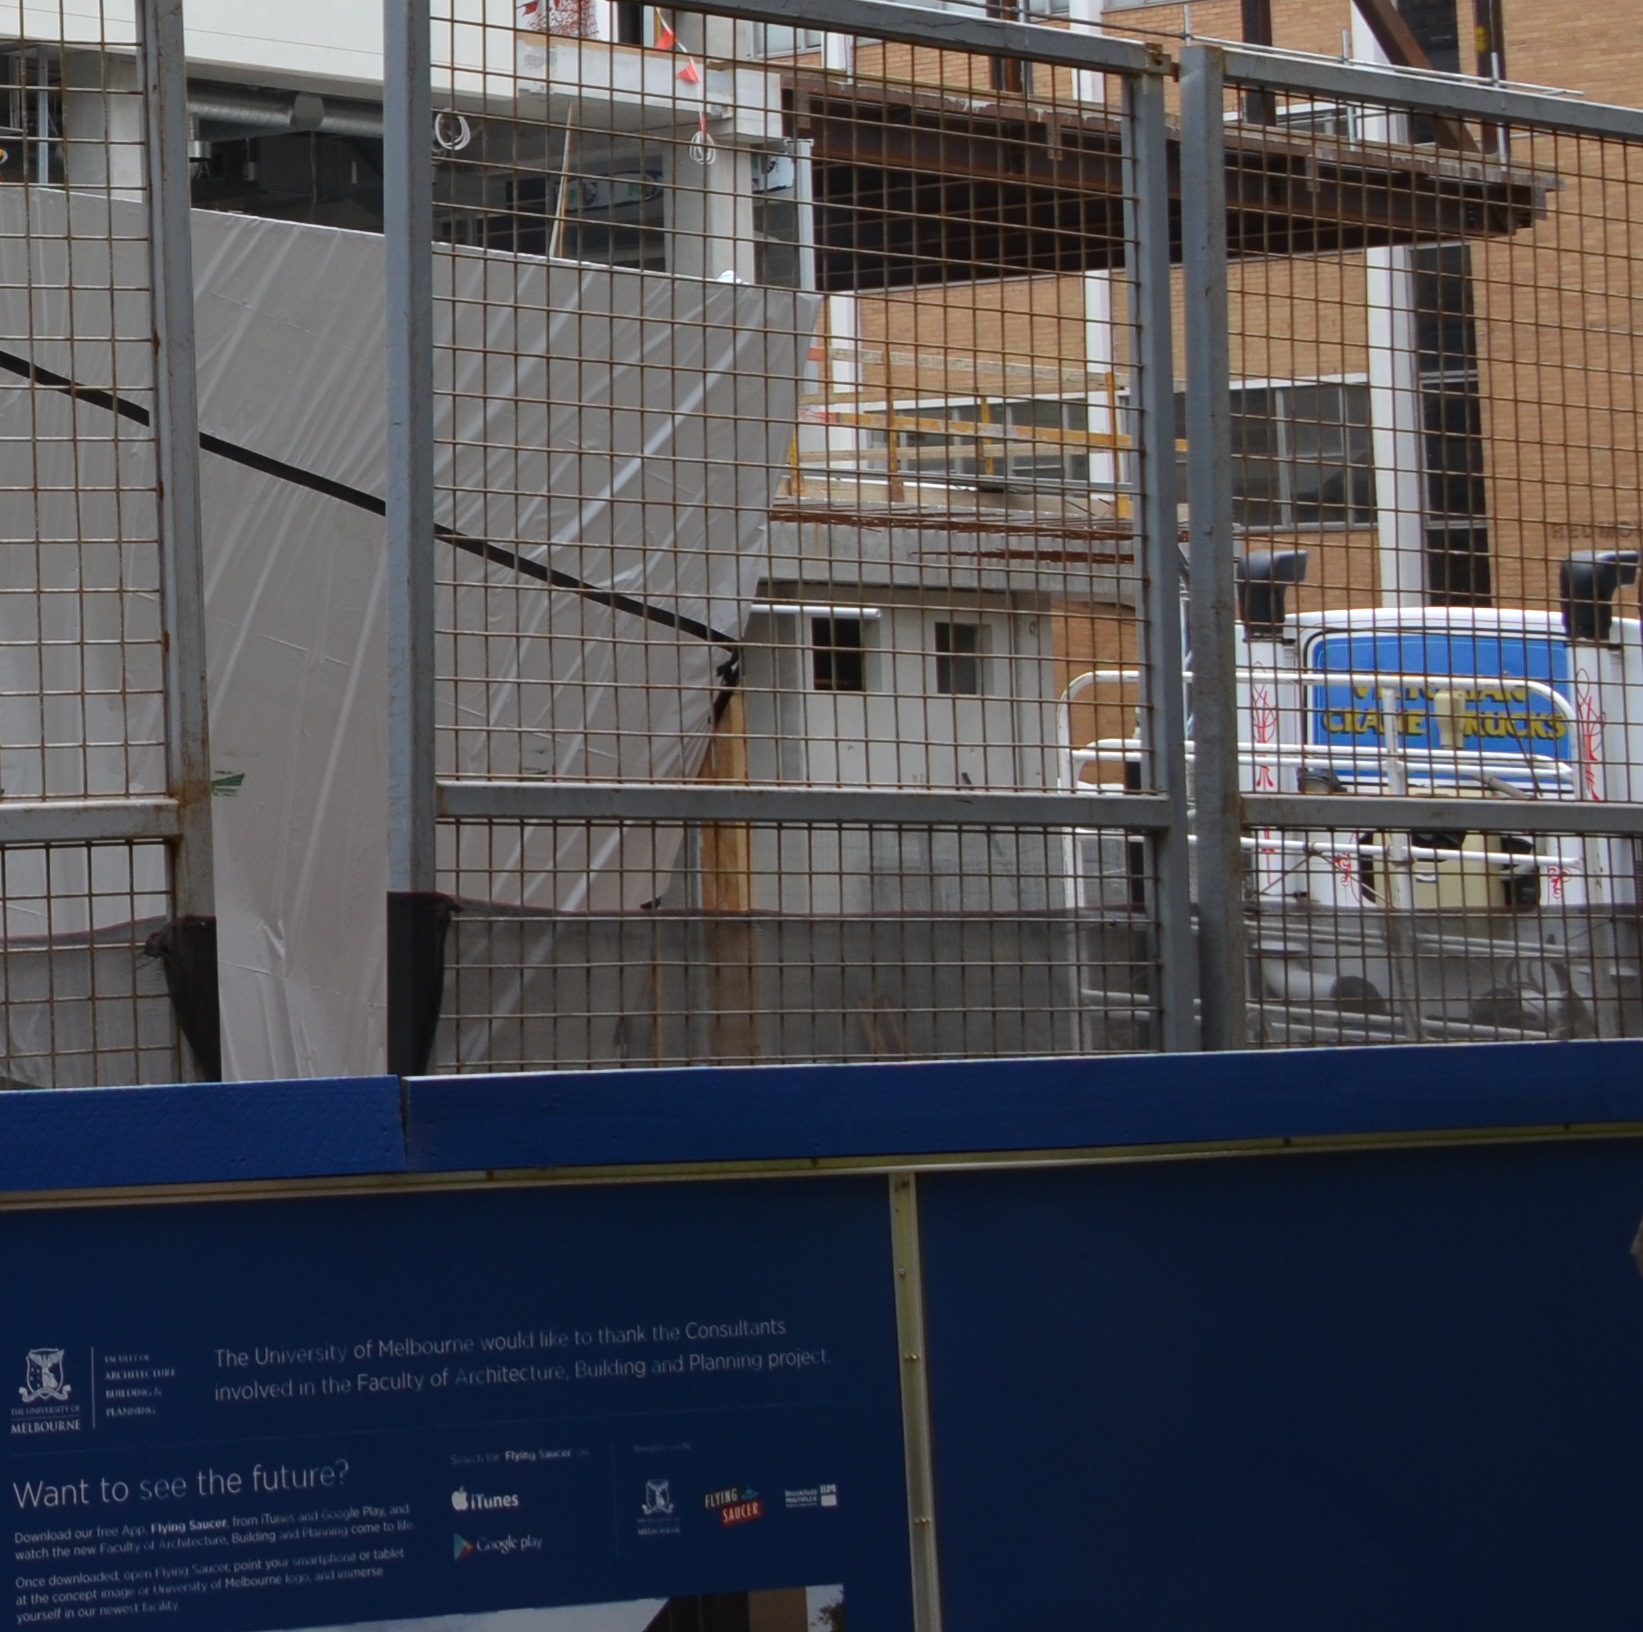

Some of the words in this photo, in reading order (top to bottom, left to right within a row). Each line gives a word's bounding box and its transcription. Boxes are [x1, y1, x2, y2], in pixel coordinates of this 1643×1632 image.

[1459, 711, 1566, 740] RUCKS
[215, 1349, 249, 1368] The
[255, 1344, 348, 1366] University
[354, 1340, 372, 1359] of
[379, 1338, 474, 1358] Melbourne
[480, 1330, 534, 1351] would
[540, 1330, 568, 1348] like
[575, 1329, 593, 1345] to
[598, 1325, 646, 1344] thank
[653, 1323, 681, 1342] the
[686, 1318, 785, 1340] Consultants
[105, 1368, 176, 1381] ARCHITECTURE
[215, 1380, 292, 1402] involved
[299, 1378, 315, 1396] in
[322, 1376, 351, 1394] the
[358, 1371, 424, 1393] Faculty
[430, 1368, 449, 1388] of
[455, 1360, 569, 1386] Architecture,
[575, 1359, 646, 1379] Building
[652, 1354, 683, 1375] and
[689, 1351, 762, 1372] Planning
[768, 1347, 831, 1370] project.
[106, 1388, 151, 1399] BUILDING
[10, 1408, 24, 1416] THE
[27, 1406, 68, 1415] UNIVERSITY
[106, 1406, 156, 1417] PLANNING
[11, 1419, 81, 1434] MELBOURNE
[450, 1452, 483, 1465] Search
[487, 1452, 500, 1463] for
[505, 1450, 536, 1462] Flying
[539, 1448, 571, 1459] Saucer
[13, 1478, 89, 1509] Want
[101, 1477, 129, 1503] to
[140, 1475, 187, 1500] see
[198, 1468, 242, 1496] the
[252, 1459, 350, 1493] future?
[471, 1493, 519, 1510] iTunes
[705, 1487, 738, 1509] FLYING
[722, 1501, 759, 1523] SAUCER
[15, 1527, 71, 1544] Download
[75, 1530, 92, 1540] our
[97, 1526, 118, 1537] free
[151, 1522, 185, 1534] Flying
[233, 1516, 258, 1527] from
[261, 1512, 294, 1525] iTunes
[298, 1510, 319, 1522] and
[322, 1506, 360, 1521] Google
[389, 1503, 409, 1515] and
[15, 1548, 49, 1561] watch
[52, 1545, 70, 1557] the
[74, 1546, 96, 1556] new
[100, 1541, 140, 1555] Faculty
[144, 1539, 155, 1551] of
[232, 1531, 276, 1545] Building
[279, 1529, 299, 1540] and
[302, 1525, 347, 1538] Planning
[351, 1523, 380, 1534] come
[383, 1522, 394, 1532] to
[476, 1534, 517, 1555] Google
[520, 1534, 542, 1550] play
[16, 1577, 45, 1589] Once
[124, 1569, 152, 1581] open
[155, 1565, 189, 1579] Flying
[234, 1558, 261, 1573] point
[266, 1557, 288, 1569] your
[293, 1553, 356, 1567] smartphone
[359, 1551, 370, 1561] or
[373, 1547, 404, 1560] tablet
[16, 1596, 27, 1606] at
[31, 1593, 49, 1604] the
[53, 1589, 96, 1603] concept
[101, 1586, 135, 1600] image
[138, 1585, 148, 1596] or
[153, 1580, 208, 1595] University
[211, 1578, 222, 1590] of
[225, 1575, 282, 1589] Melbourne
[315, 1570, 335, 1582] and
[338, 1567, 383, 1579] immerse
[17, 1608, 61, 1625] yourself
[65, 1606, 74, 1618] in
[78, 1605, 96, 1617] our
[100, 1603, 138, 1616] newest
